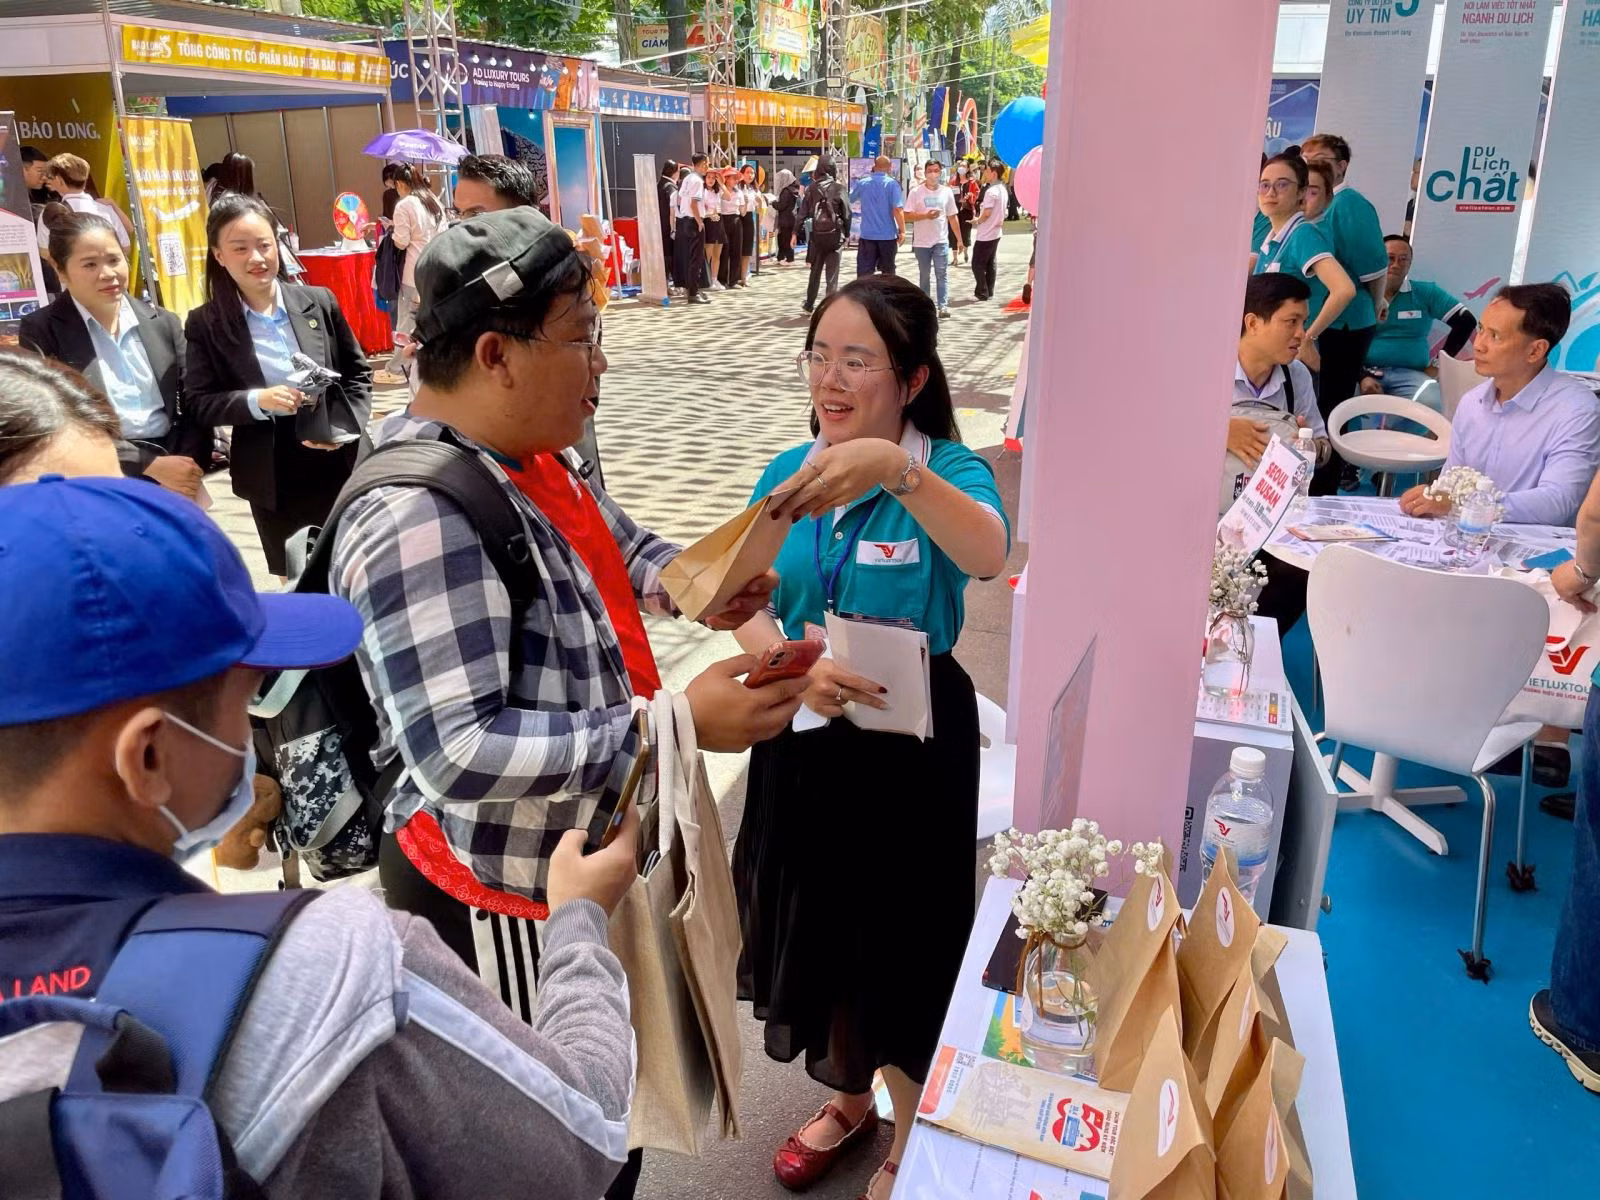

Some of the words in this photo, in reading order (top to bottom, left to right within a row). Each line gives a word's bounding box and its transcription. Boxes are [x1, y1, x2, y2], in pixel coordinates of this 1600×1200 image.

[1346, 8, 1365, 24] UY
[1497, 12, 1511, 24] DU
[641, 36, 668, 48] GIẢM
[205, 43, 231, 61] CÔNG
[232, 48, 243, 62] TY
[472, 67, 483, 78] AD
[484, 68, 509, 81] LUXURY
[509, 71, 530, 83] TOURS
[20, 115, 53, 139] BẢO
[787, 127, 829, 141] VISA
[1474, 146, 1496, 157] DU
[1472, 157, 1510, 174] Lịch
[1426, 146, 1520, 203] chất
[1265, 461, 1289, 491] SEOUL
[1255, 477, 1281, 509] BUSAN
